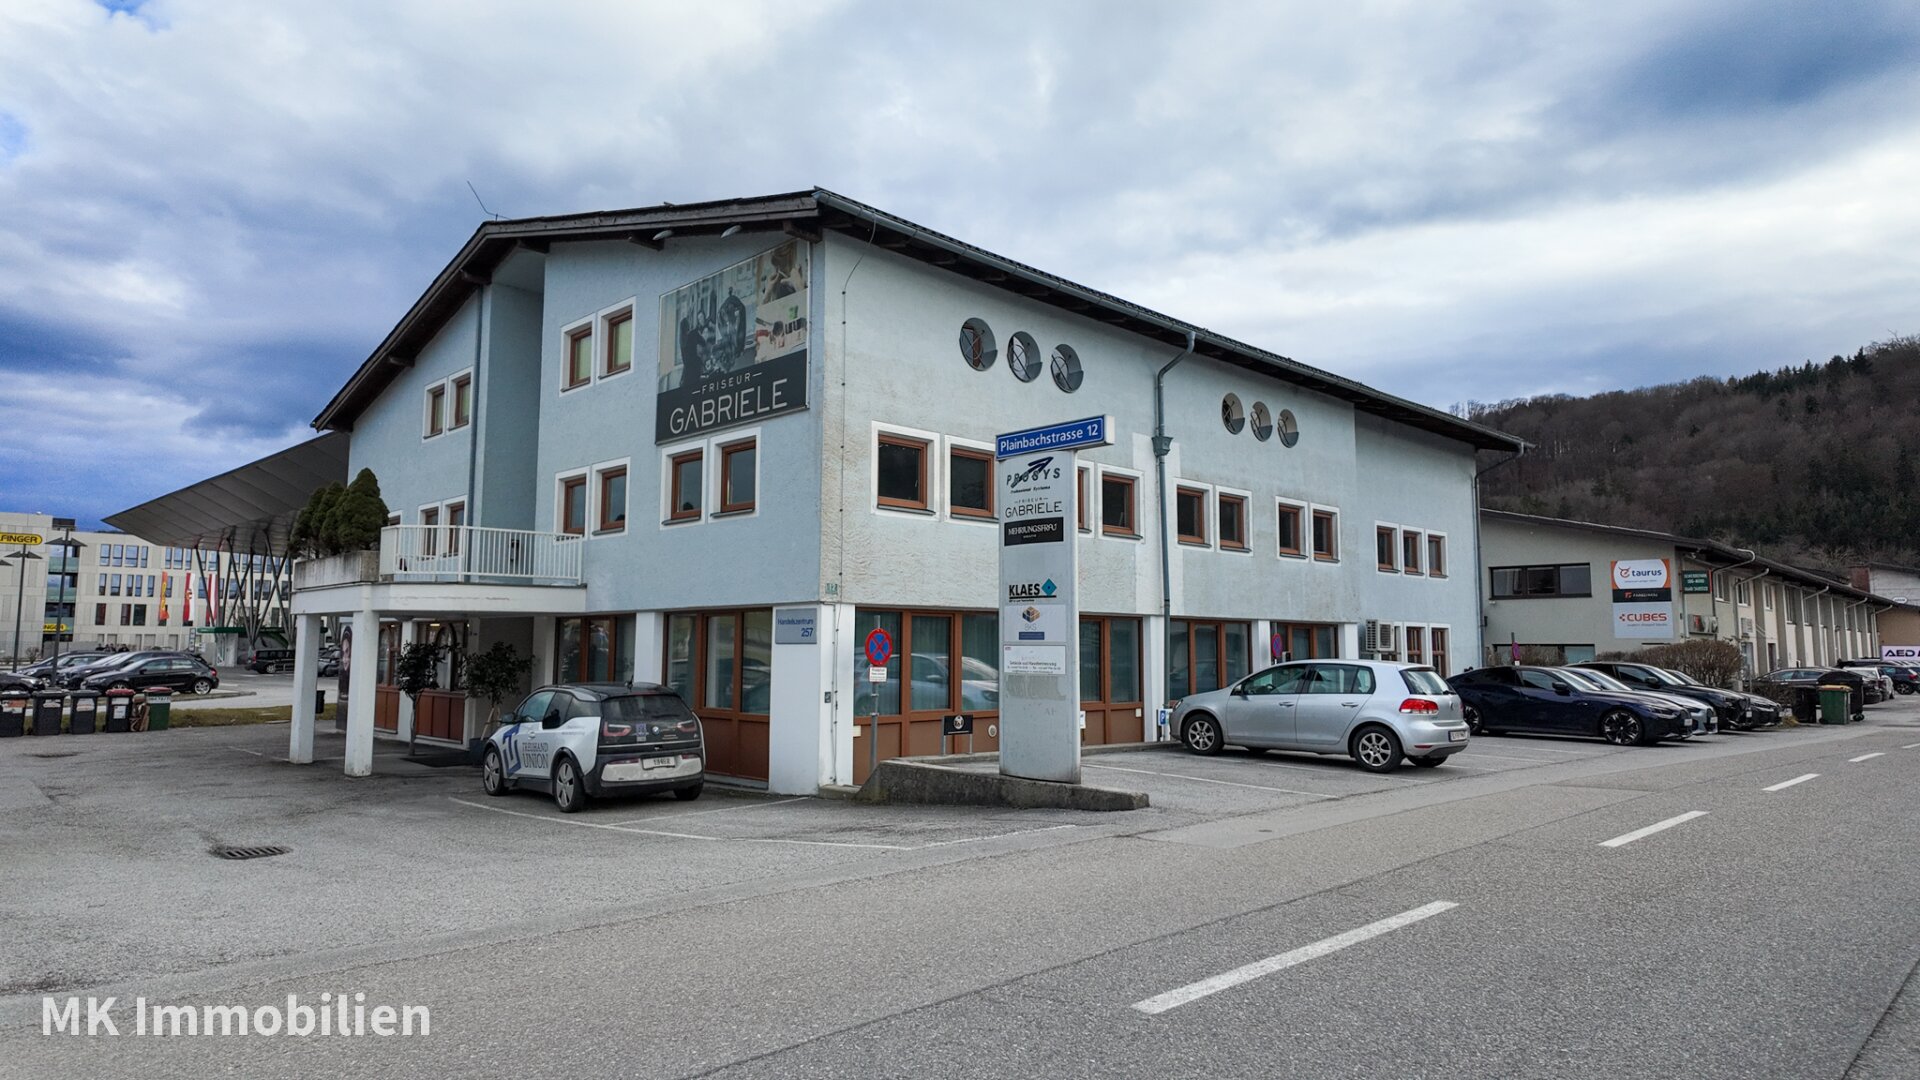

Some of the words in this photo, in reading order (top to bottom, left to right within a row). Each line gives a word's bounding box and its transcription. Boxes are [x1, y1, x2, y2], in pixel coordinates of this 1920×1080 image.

[702, 372, 750, 395] FRISEUR
[669, 378, 788, 434] GABRIELE
[1000, 429, 1083, 452] Plainbachstrasse
[1087, 423, 1099, 436] 12
[1005, 501, 1063, 518] GABRIELE
[0, 534, 38, 543] FINGER
[1631, 569, 1662, 577] taurus
[1009, 583, 1040, 596] KLAES
[1626, 613, 1668, 622] CUBES
[801, 627, 813, 637] 257
[1885, 649, 1915, 657] AED
[522, 742, 549, 752] TREUHAND
[523, 753, 549, 768] UNION
